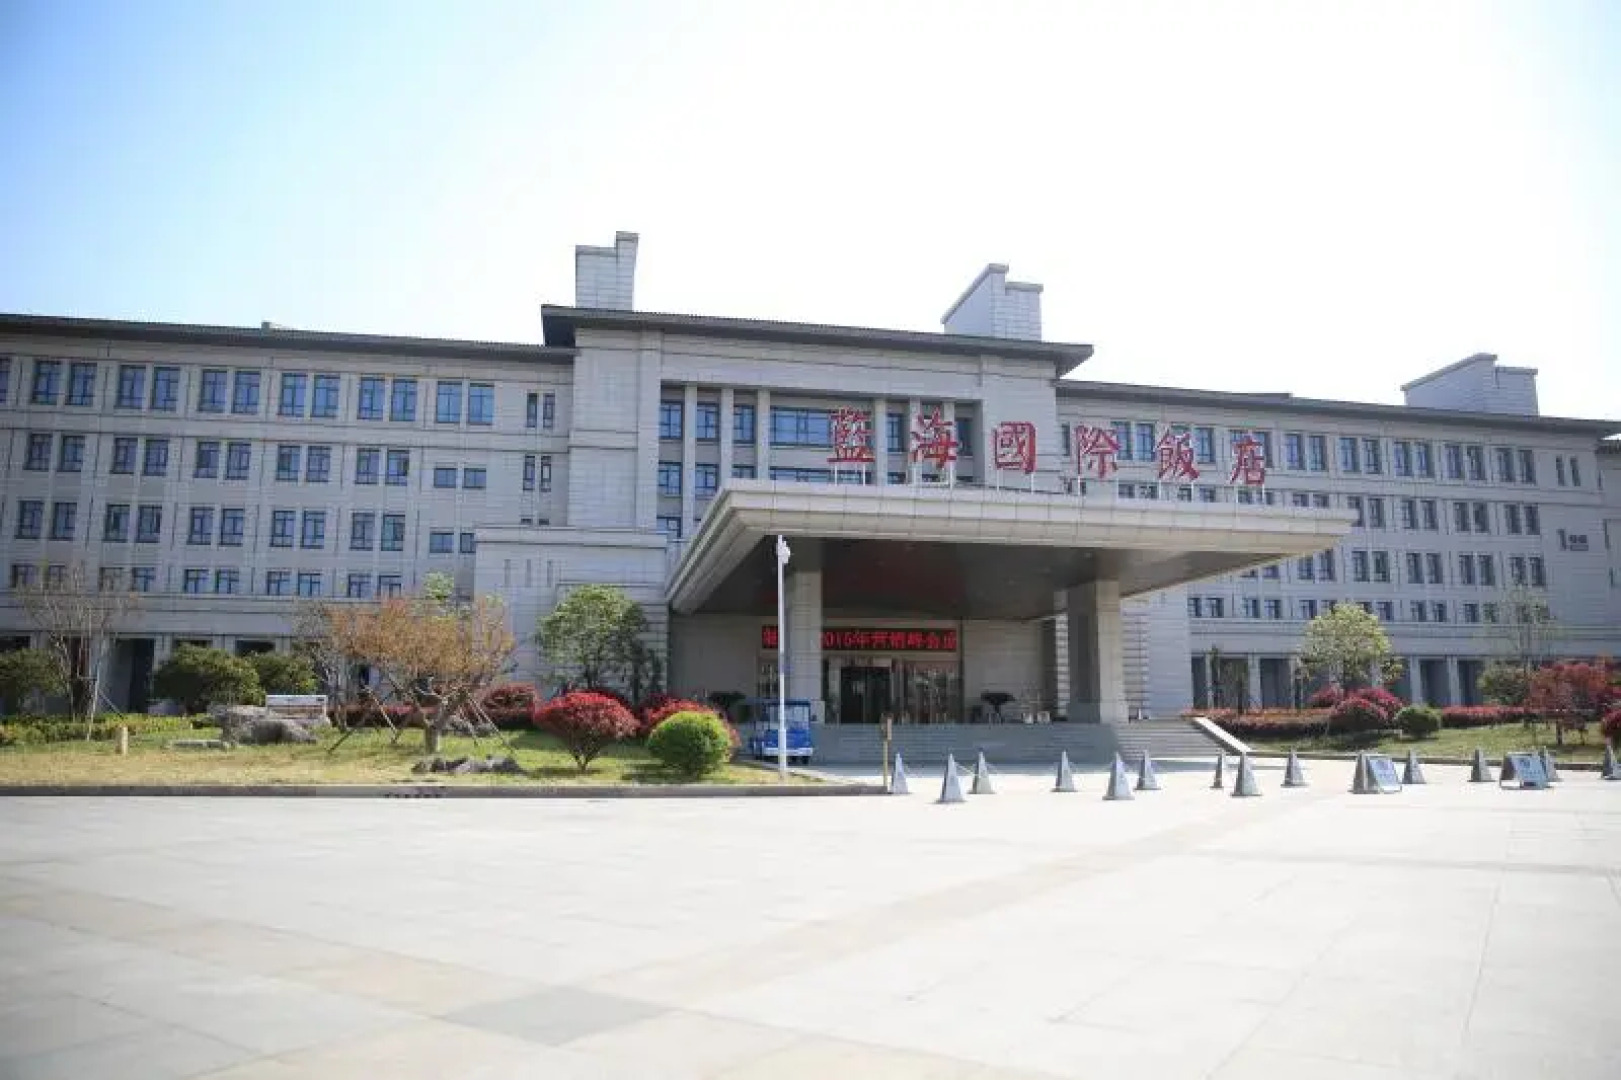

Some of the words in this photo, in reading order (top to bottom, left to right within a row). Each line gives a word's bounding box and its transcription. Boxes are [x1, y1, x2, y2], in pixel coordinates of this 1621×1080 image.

[827, 406, 1265, 486] 藍海國際飯店
